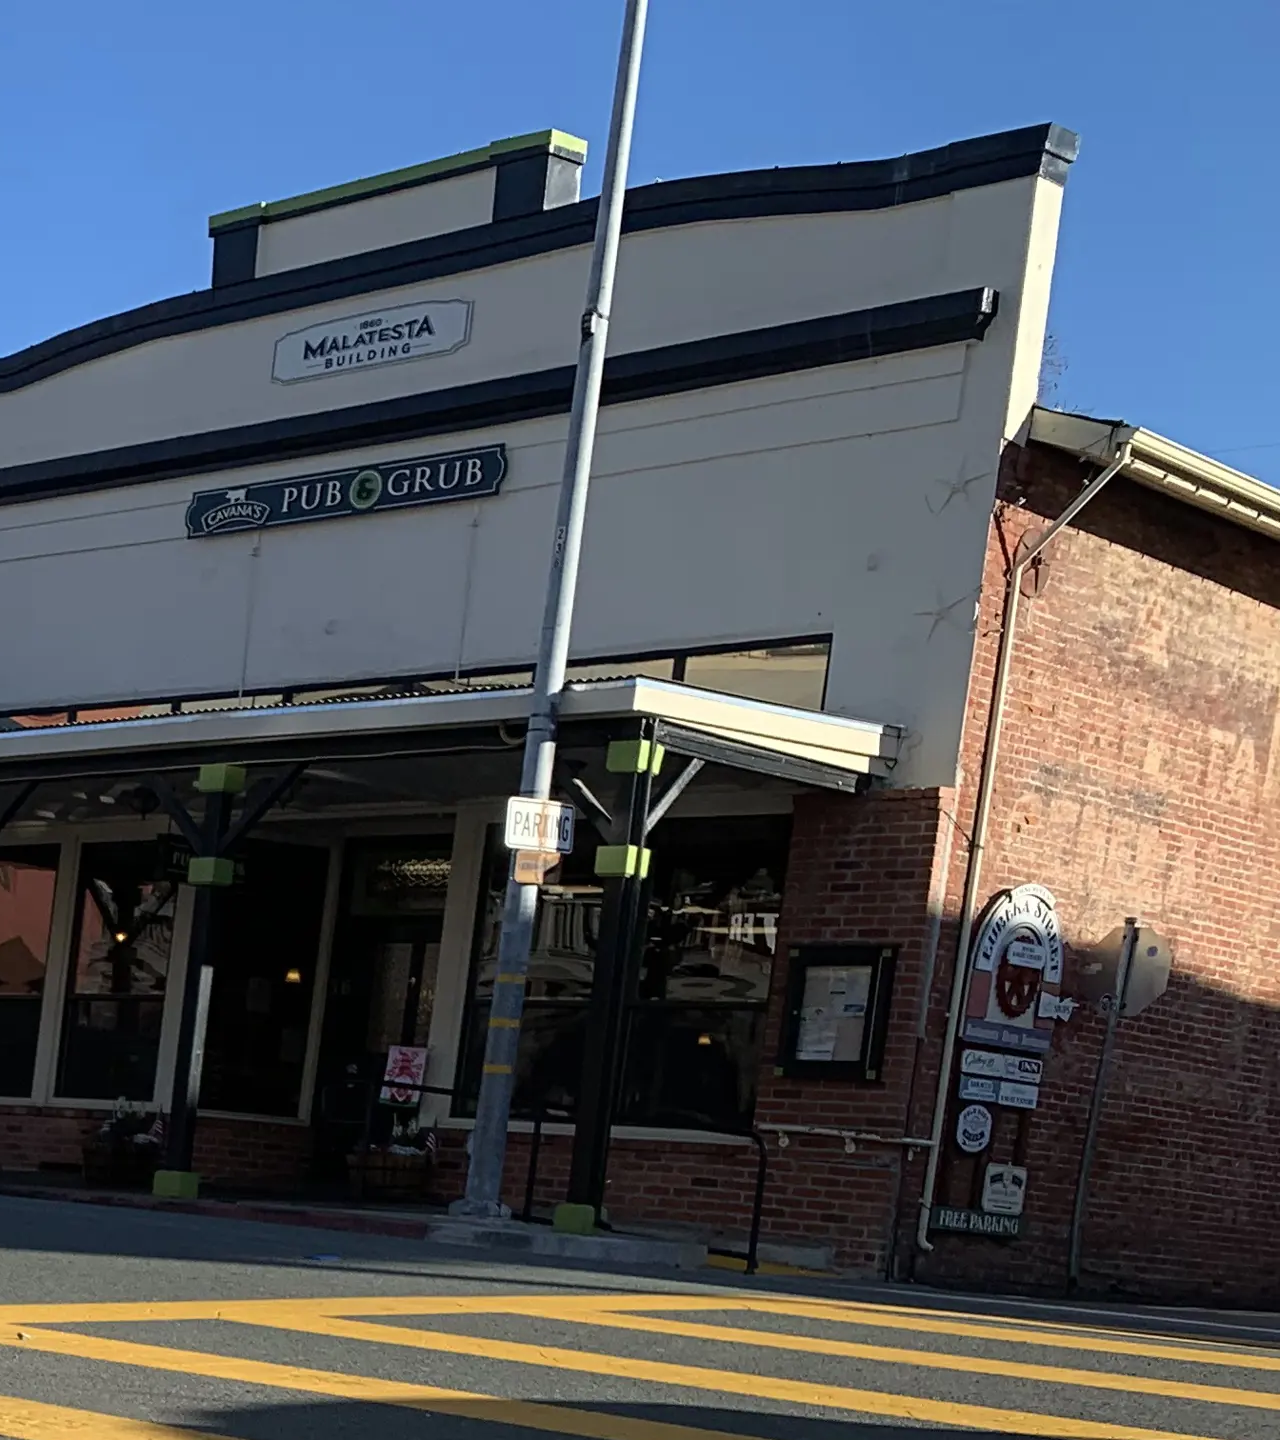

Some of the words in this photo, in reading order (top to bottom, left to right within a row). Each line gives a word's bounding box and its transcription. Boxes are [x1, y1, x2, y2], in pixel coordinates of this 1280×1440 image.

[303, 315, 436, 360] MALATESTA
[324, 343, 411, 369] BUILDING
[281, 480, 342, 513] PUB
[387, 458, 483, 496] GRUB
[207, 503, 264, 526] CAVANA'S
[513, 811, 570, 842] PARKING
[982, 900, 1030, 961] EUREKA
[1034, 902, 1059, 973] STREET
[939, 1210, 968, 1229] FREE
[969, 1213, 1019, 1235] PARKING
